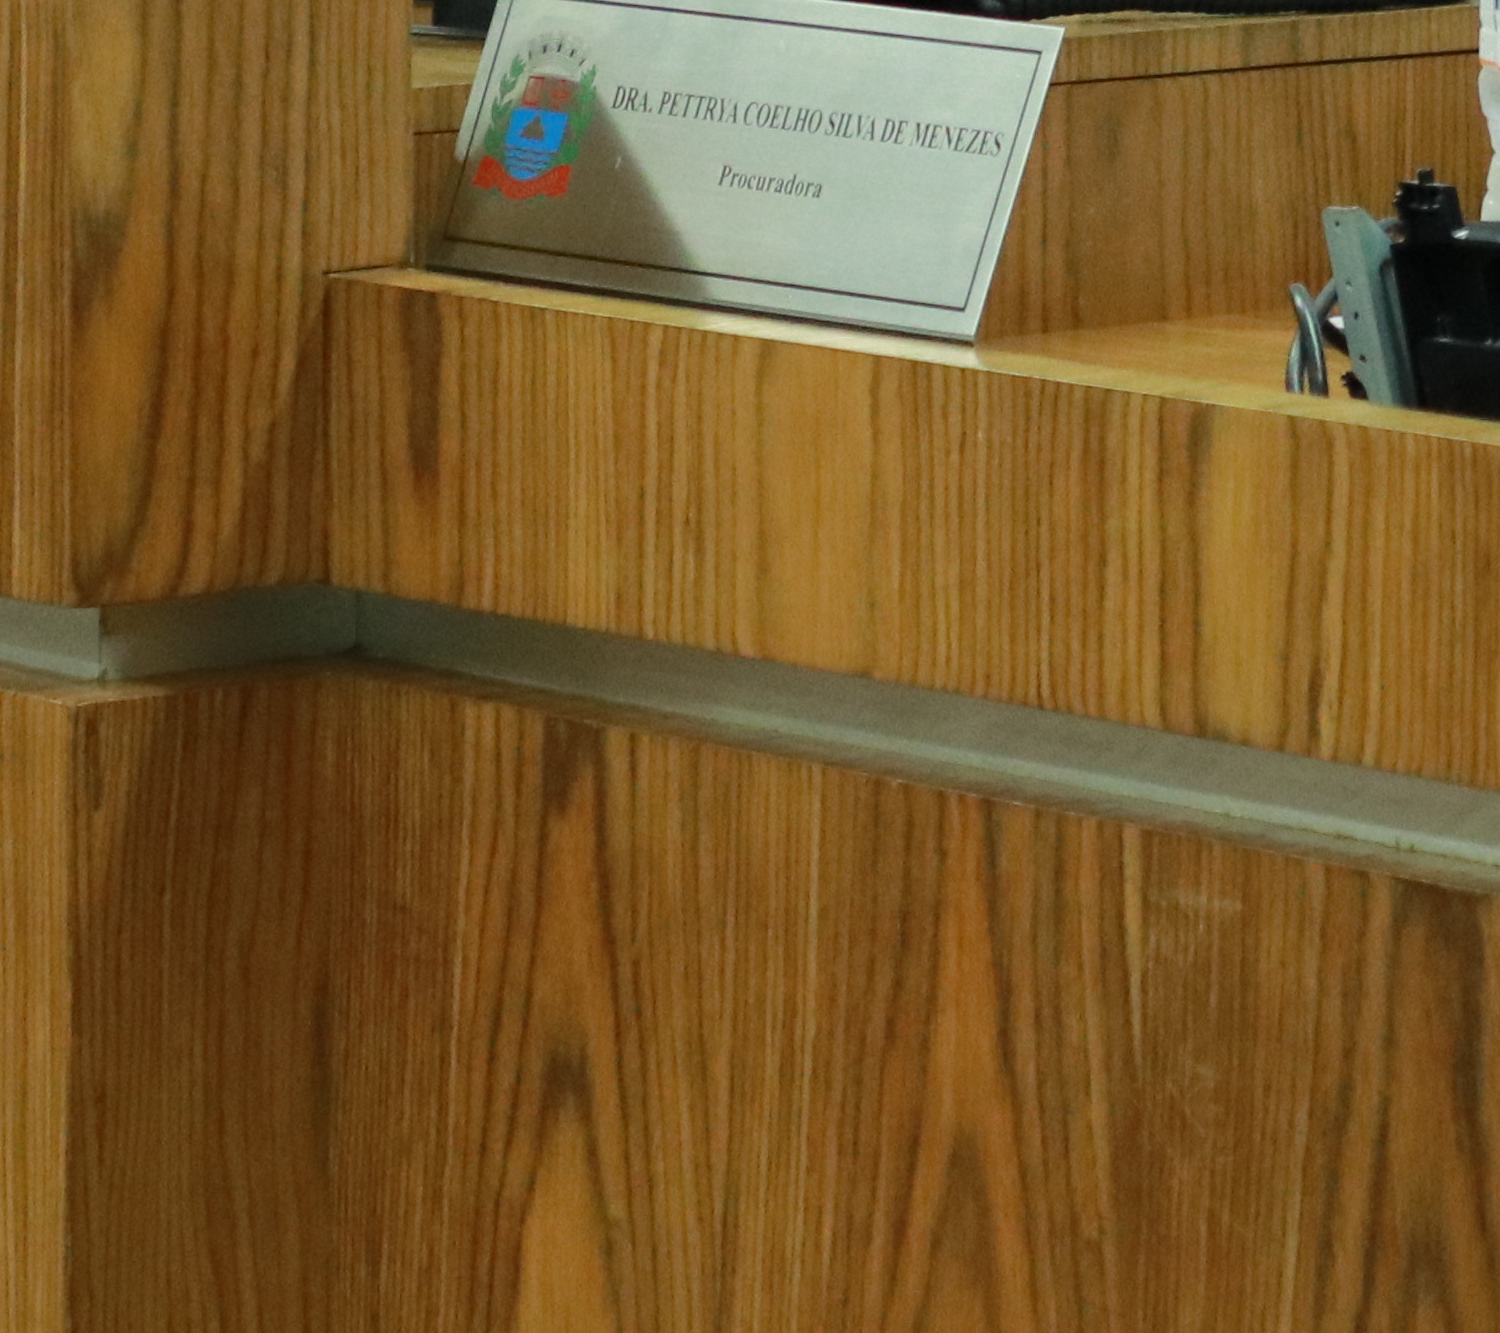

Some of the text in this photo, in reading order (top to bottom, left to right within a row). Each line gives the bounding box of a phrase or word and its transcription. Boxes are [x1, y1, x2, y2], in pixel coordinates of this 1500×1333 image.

[611, 85, 1005, 158] DRA. PETTRYA COELHO SILVA DE MENEZES
[717, 164, 823, 200] Procuradora
